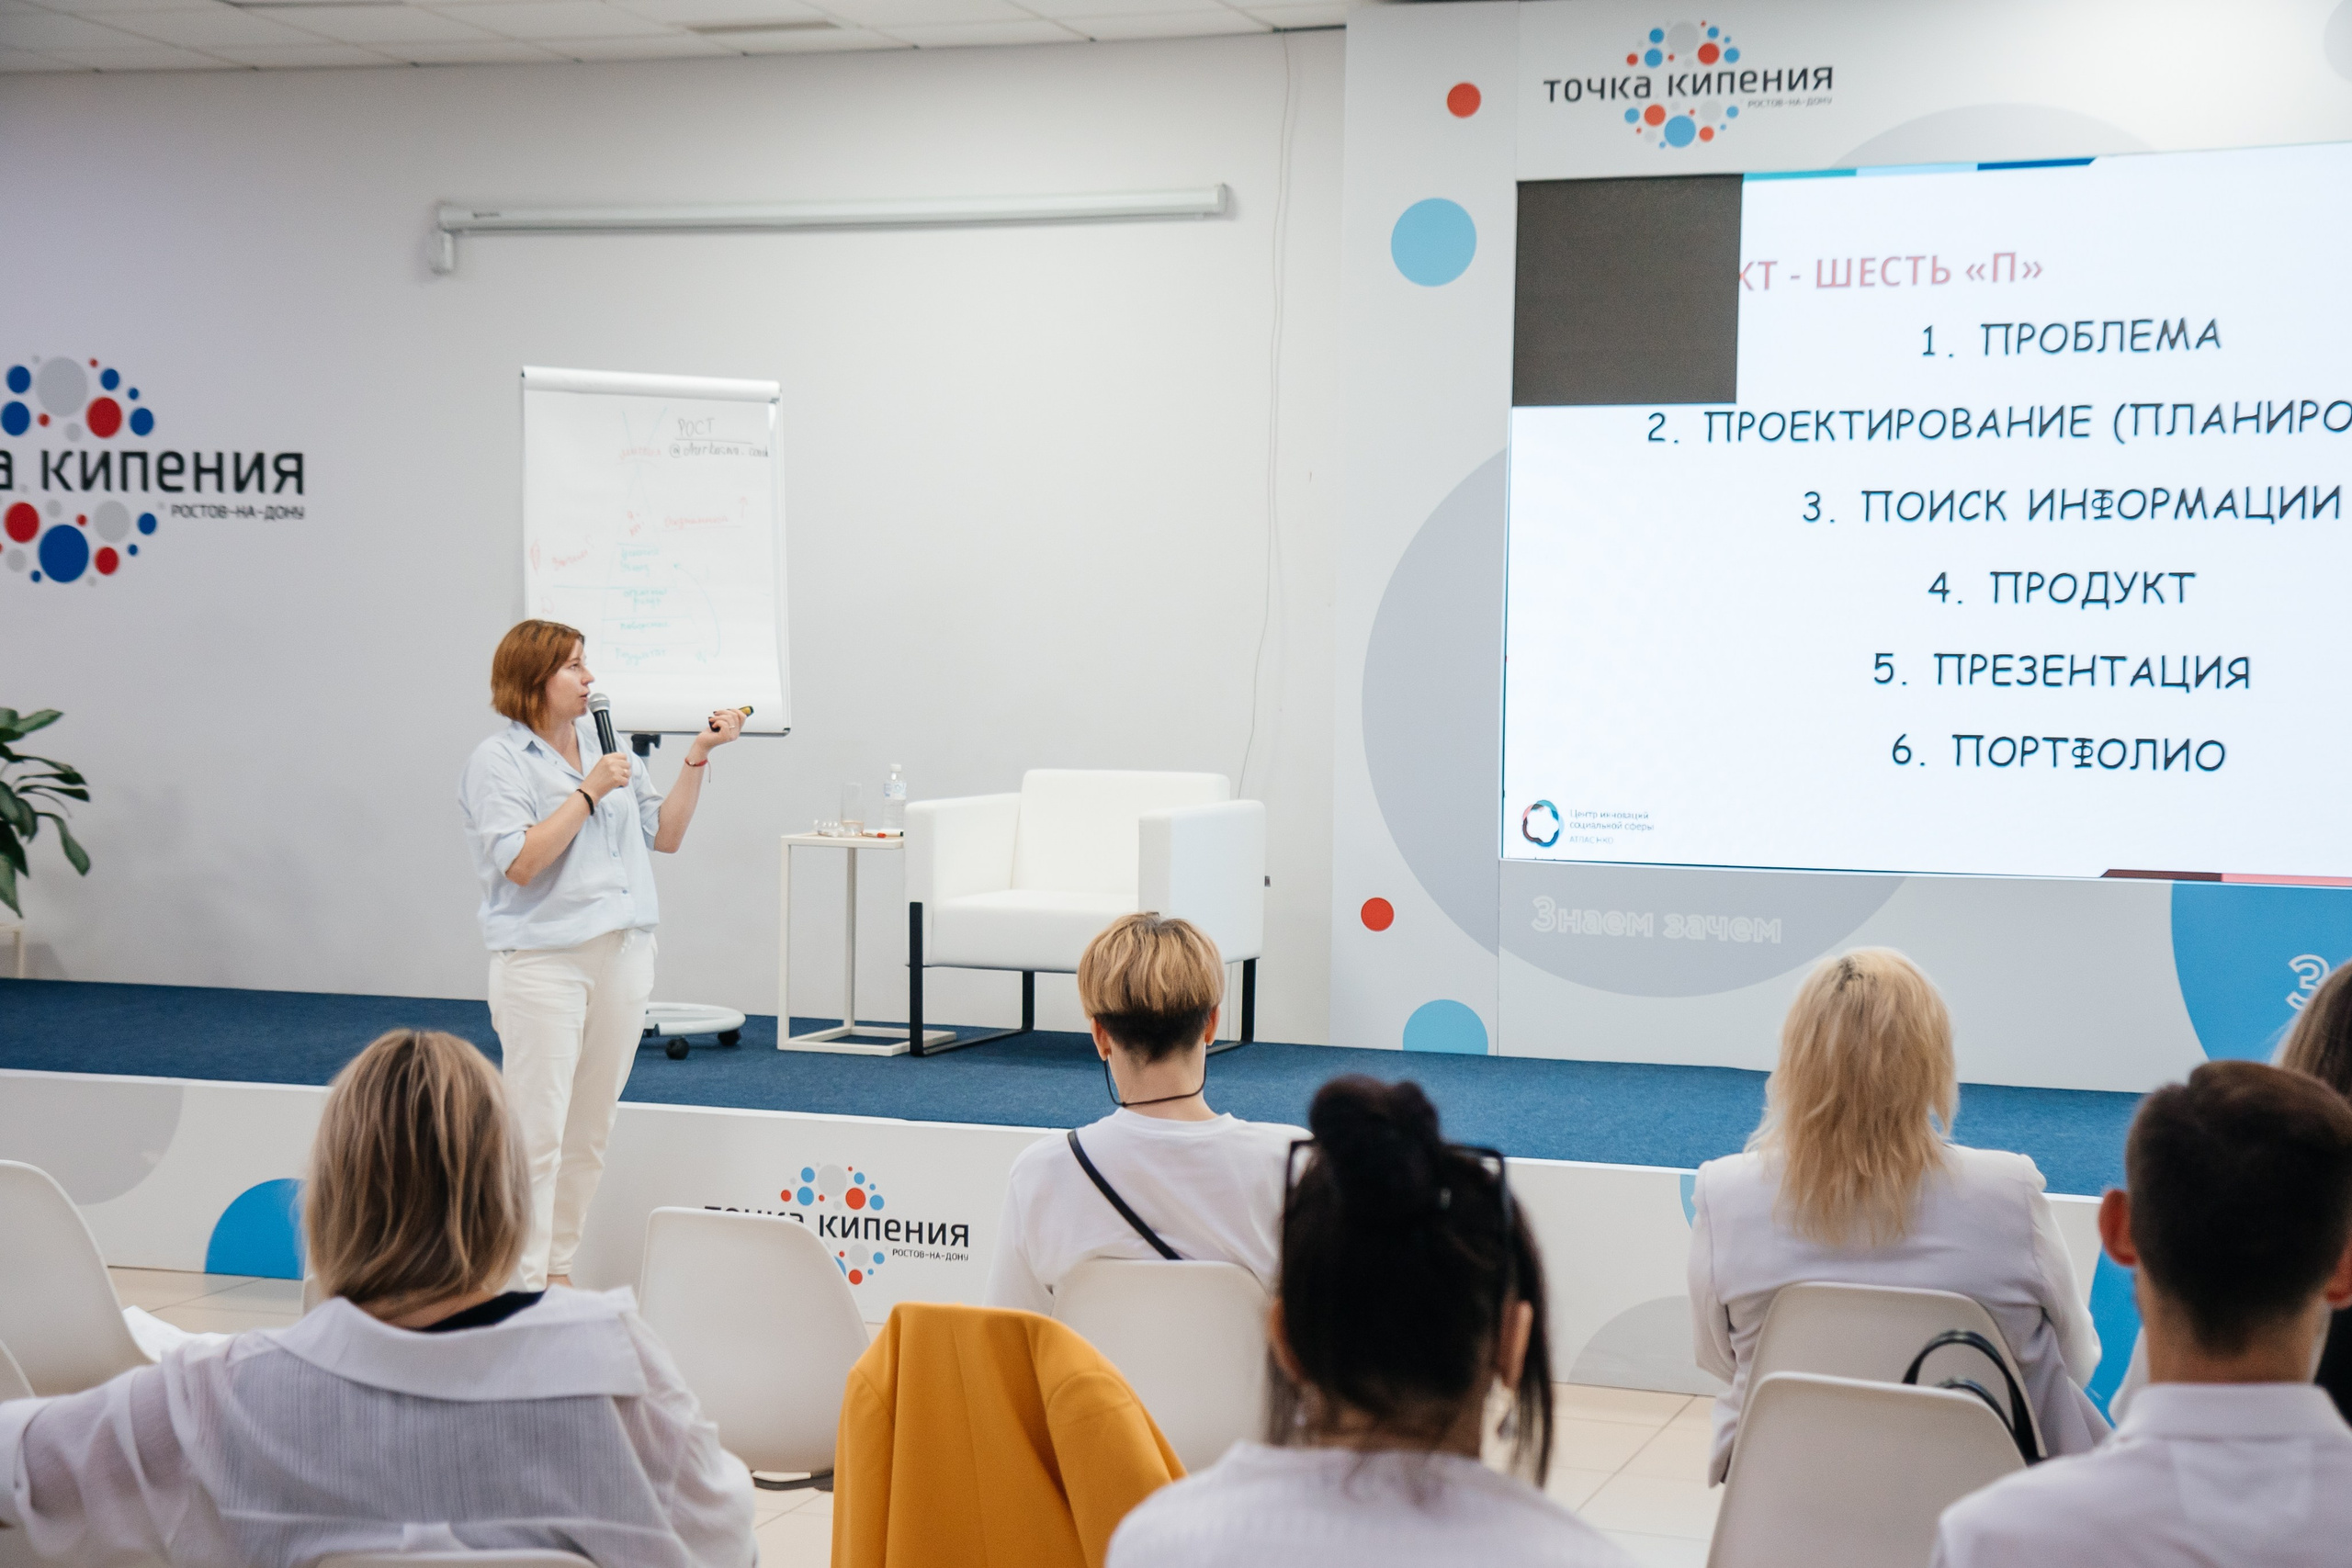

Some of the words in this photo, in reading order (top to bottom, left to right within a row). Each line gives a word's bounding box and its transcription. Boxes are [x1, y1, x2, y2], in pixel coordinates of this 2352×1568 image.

[1815, 254, 1952, 289] ШЕСТЬ
[1964, 251, 2044, 283] «П»
[1922, 324, 1955, 358] 1.
[1980, 317, 2222, 357] ПРОБЛЕМА
[1647, 412, 1680, 445] 2.
[1703, 404, 2094, 444] ПРОЕКТИРОВАНИЕ
[2113, 399, 2352, 446] (ПЛАНИРО
[1802, 491, 1837, 525] 3.
[1860, 489, 2008, 524] ПОИСК
[2028, 484, 2341, 525] ИНФОРМАЦИИ
[1927, 571, 1964, 605] 4.
[1989, 570, 2198, 611] ПРОДУКТ
[1873, 652, 1908, 687] 5.
[1932, 652, 2250, 694] ПРЕЗЕНТАЦИЯ
[1892, 733, 1926, 768] 6.
[1951, 733, 2227, 773] ПОРТФОЛИО
[1532, 895, 1654, 937] Знаем
[1663, 913, 1782, 944] зачем
[892, 1247, 969, 1261] РОСТОВ-НА-ДОНУ
